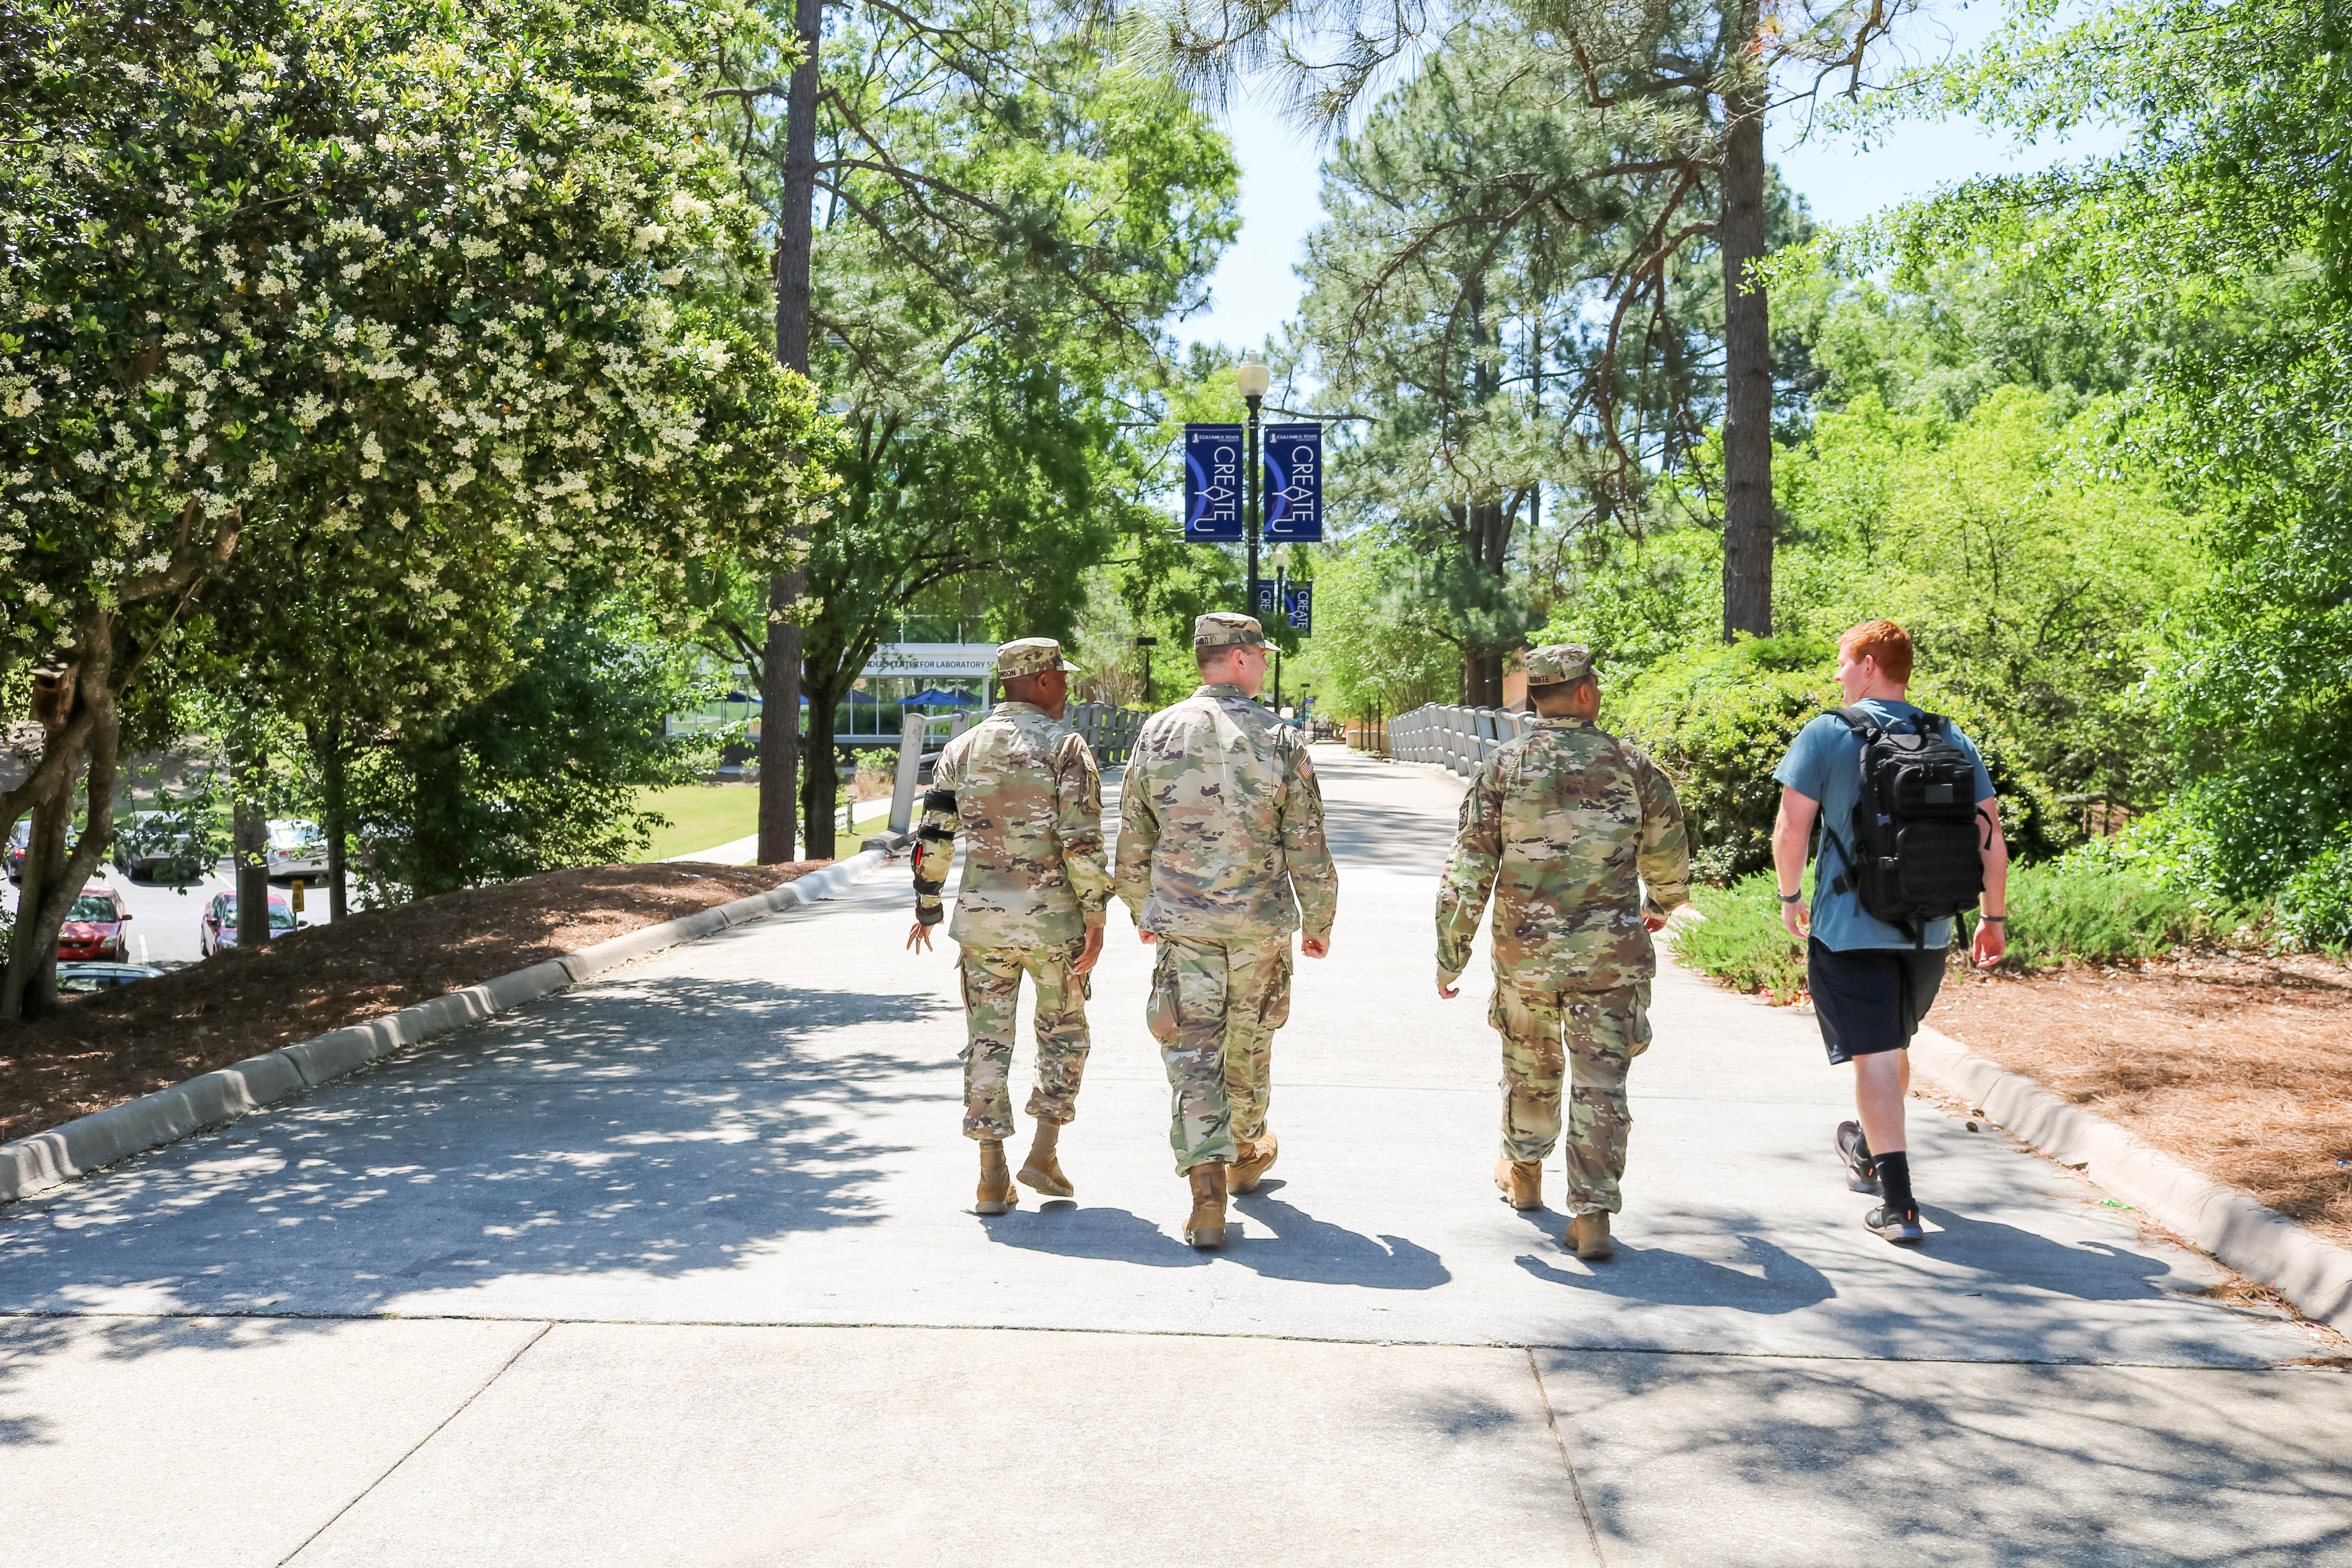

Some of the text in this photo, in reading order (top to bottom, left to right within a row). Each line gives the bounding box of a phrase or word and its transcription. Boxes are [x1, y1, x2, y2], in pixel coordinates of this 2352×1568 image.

[1214, 446, 1235, 521] CREATE
[1292, 446, 1313, 521] CREATE
[1297, 591, 1309, 628] CREATE
